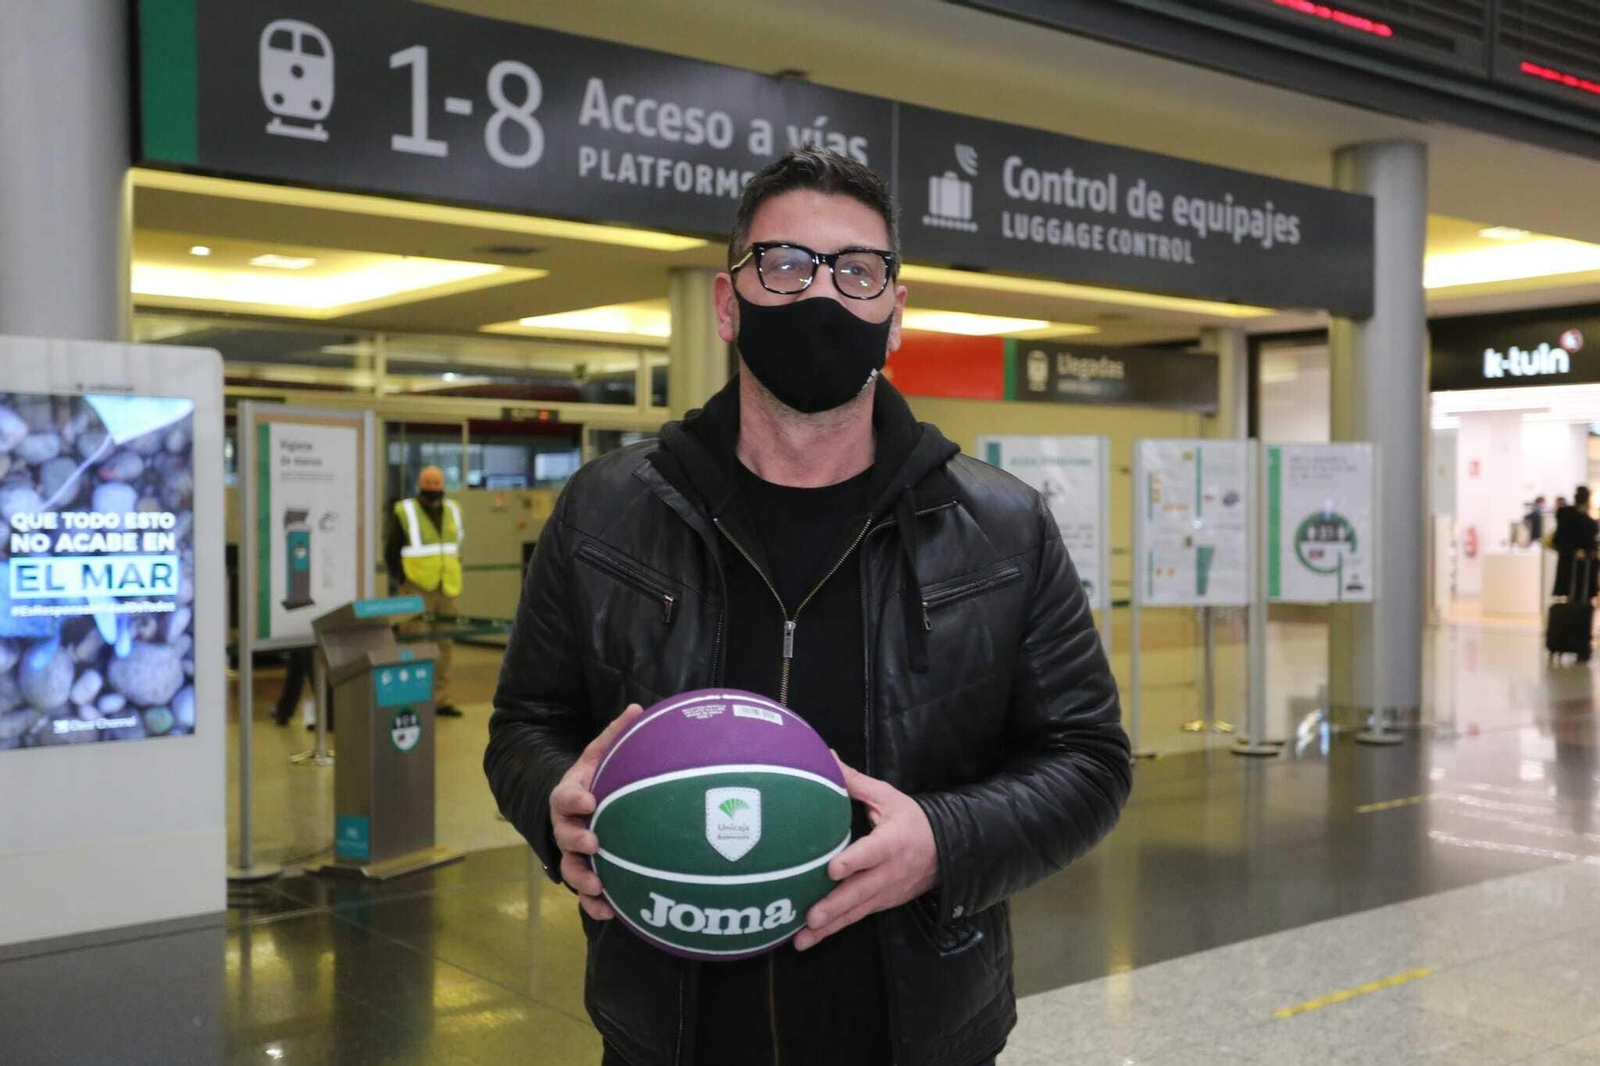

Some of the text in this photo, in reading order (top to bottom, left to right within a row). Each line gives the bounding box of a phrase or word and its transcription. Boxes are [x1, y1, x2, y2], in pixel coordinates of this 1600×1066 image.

[389, 45, 545, 169] 1-8
[578, 77, 869, 167] Acceso a vías
[1002, 154, 1302, 249] Control de equipajes
[1002, 210, 1194, 266] LUGGAGE CONTROL
[1484, 342, 1570, 378] k-tuin
[10, 511, 176, 532] QUE TODO ESTO
[10, 531, 176, 553] NO ACABE EN
[15, 562, 174, 592] EL MAR
[640, 892, 796, 935] Joma
